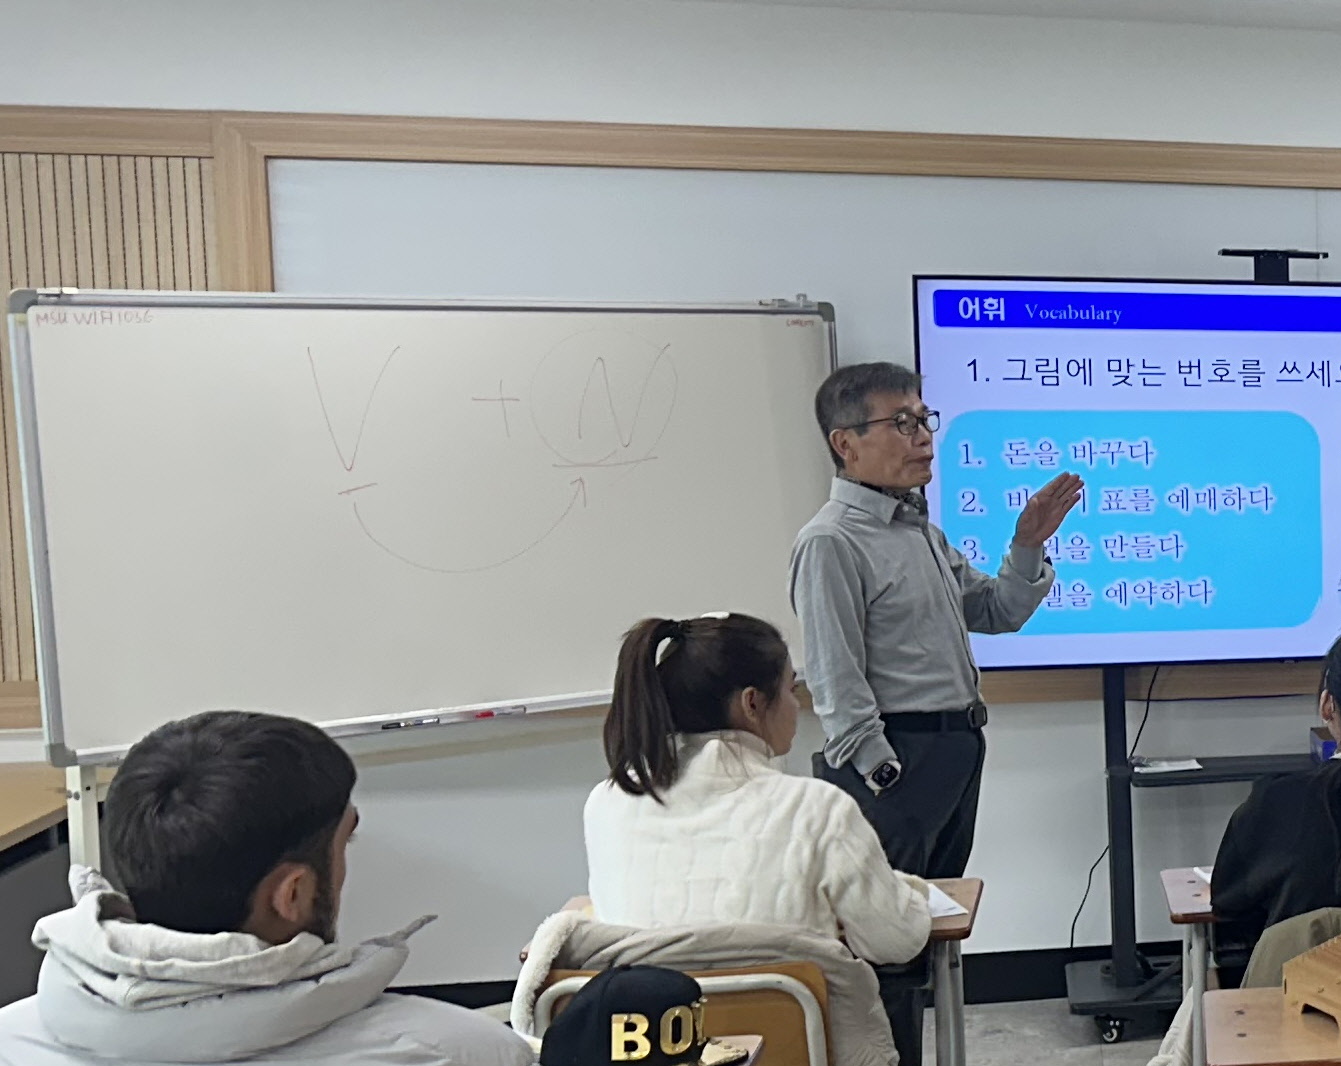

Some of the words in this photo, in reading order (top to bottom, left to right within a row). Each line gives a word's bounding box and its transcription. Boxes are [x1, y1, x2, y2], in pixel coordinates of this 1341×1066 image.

[958, 296, 1005, 322] 어휘
[1024, 303, 1122, 325] Vocabulary
[967, 358, 990, 382] 1.
[1002, 357, 1092, 387] 그림에
[1107, 358, 1166, 387] 맞는
[1178, 358, 1266, 388] 번호를
[307, 346, 400, 471] V
[961, 443, 982, 465] 1.
[1005, 440, 1060, 467] 돈을
[1071, 440, 1155, 467] 바꾸다
[961, 490, 984, 513] 2.
[1102, 488, 1155, 513] 표를
[1167, 485, 1274, 512] 예매하다
[963, 538, 986, 561] 3.
[1104, 533, 1184, 560] 만들다
[1105, 579, 1213, 607] 예약하다
[611, 996, 708, 1064] BO
